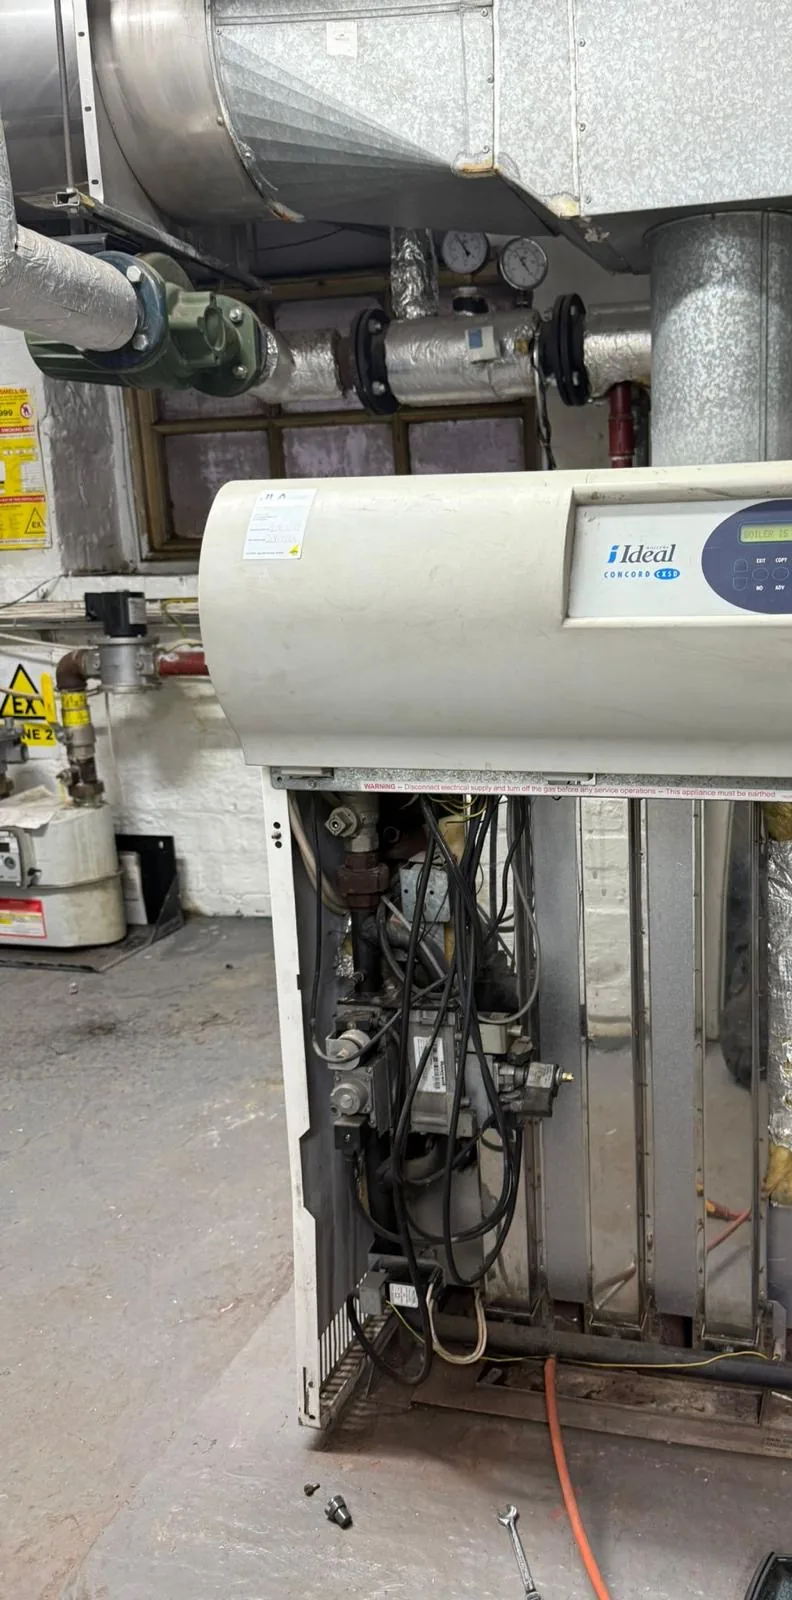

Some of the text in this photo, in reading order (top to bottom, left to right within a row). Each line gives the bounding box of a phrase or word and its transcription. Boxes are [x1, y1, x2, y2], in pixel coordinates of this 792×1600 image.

[744, 529, 774, 539] BOILER
[619, 543, 676, 563] Ideal
[13, 697, 36, 714] EX
[45, 729, 53, 740] 2
[404, 783, 440, 791] Disconnect
[471, 785, 492, 793] supply
[580, 786, 592, 795] any
[682, 789, 716, 797] appliance
